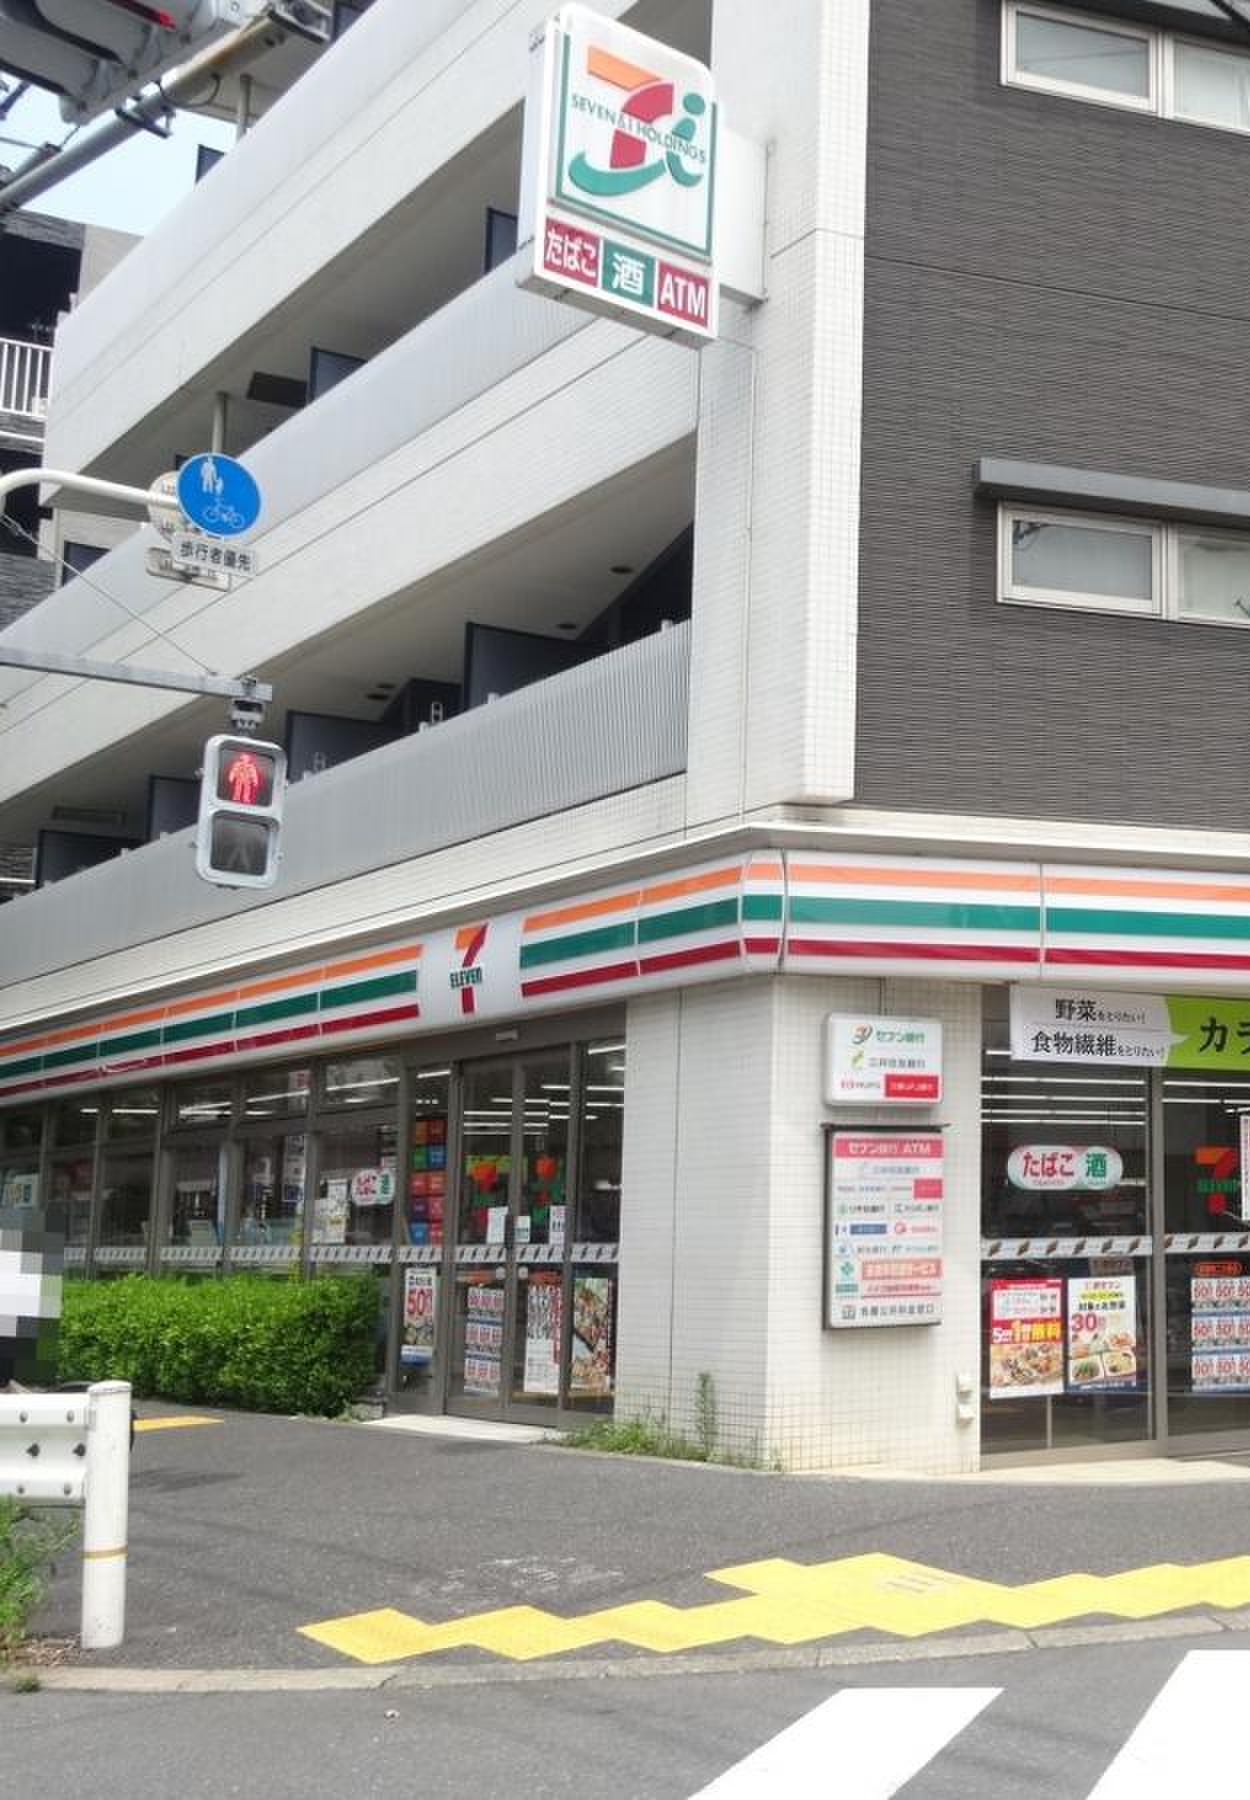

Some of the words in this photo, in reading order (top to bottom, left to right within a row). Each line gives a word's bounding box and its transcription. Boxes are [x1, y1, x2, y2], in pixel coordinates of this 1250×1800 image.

[546, 228, 597, 277] たばこ
[612, 252, 647, 295] 酒
[660, 272, 706, 319] ATM
[1023, 1152, 1074, 1177] たばこ
[1086, 1153, 1107, 1177] 酒
